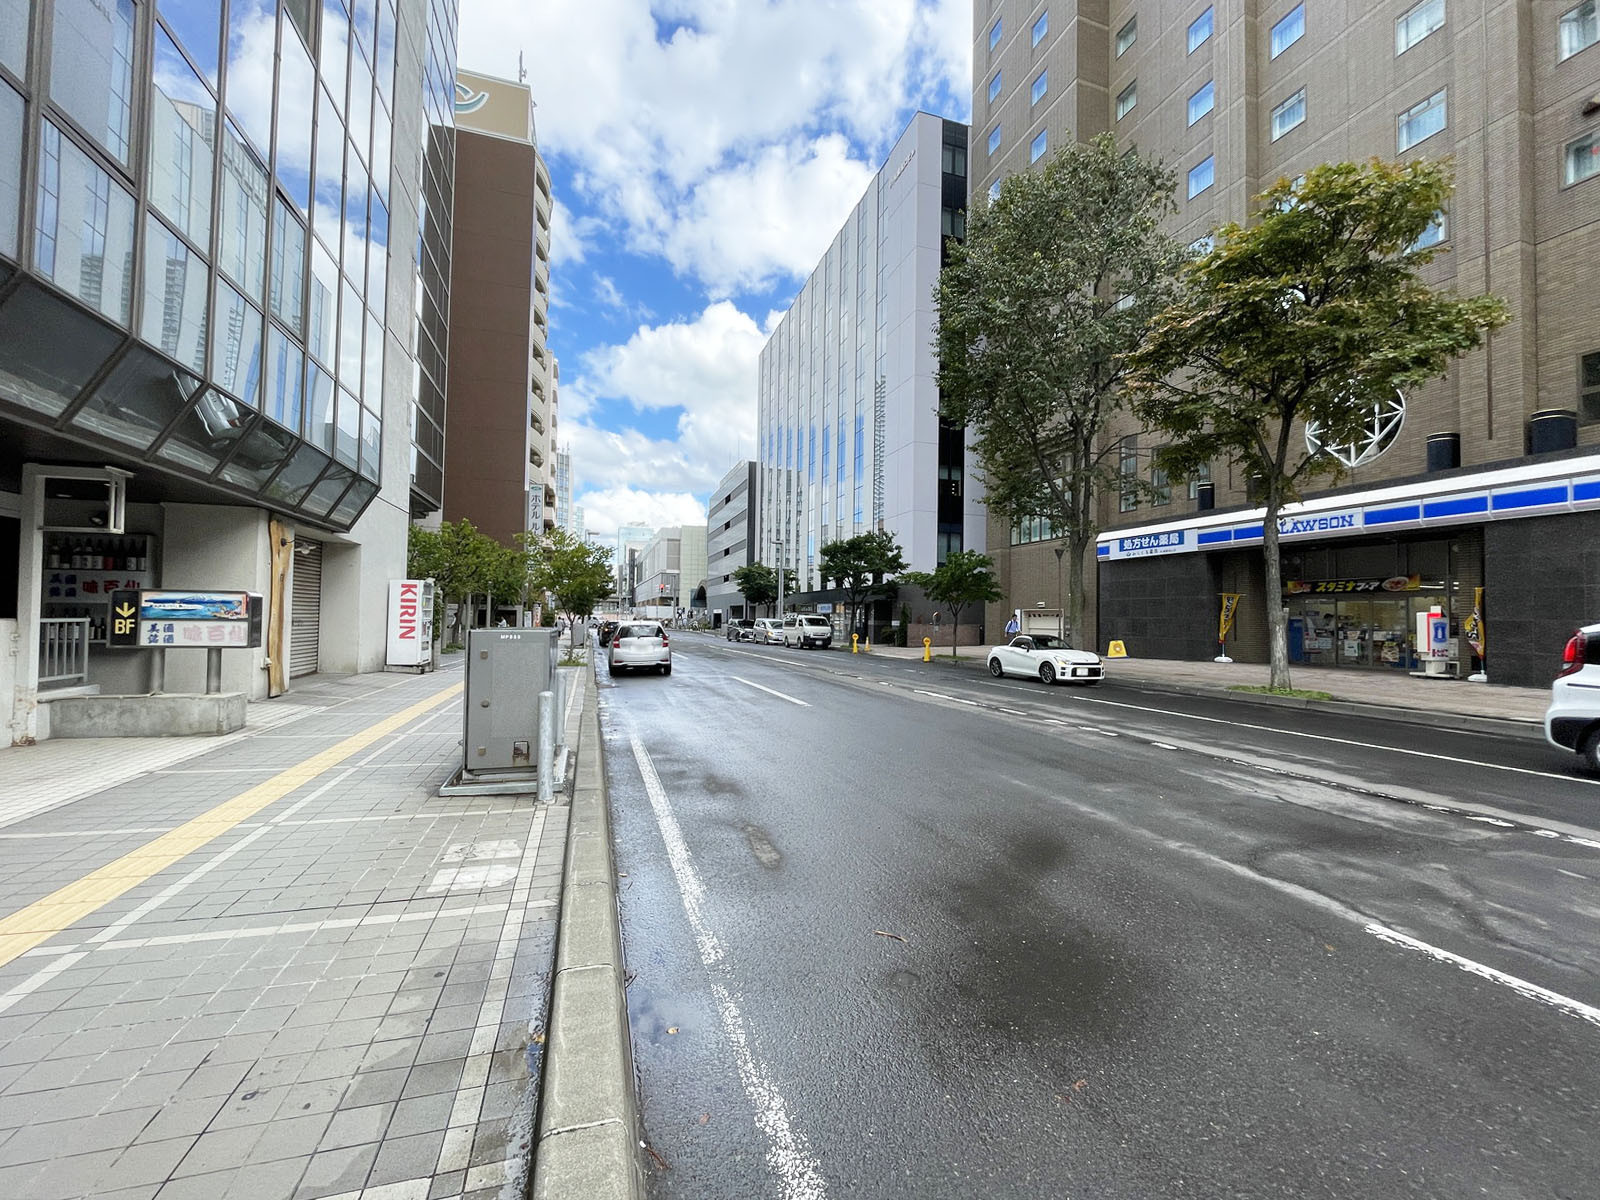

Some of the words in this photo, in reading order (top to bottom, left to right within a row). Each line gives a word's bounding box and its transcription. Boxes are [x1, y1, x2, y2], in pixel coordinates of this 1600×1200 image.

[531, 494, 541, 519] ホテル
[1280, 514, 1354, 534] LAWSON
[1123, 532, 1179, 550] 処方せん薬局
[399, 583, 418, 639] KIRIN
[114, 618, 135, 634] BF
